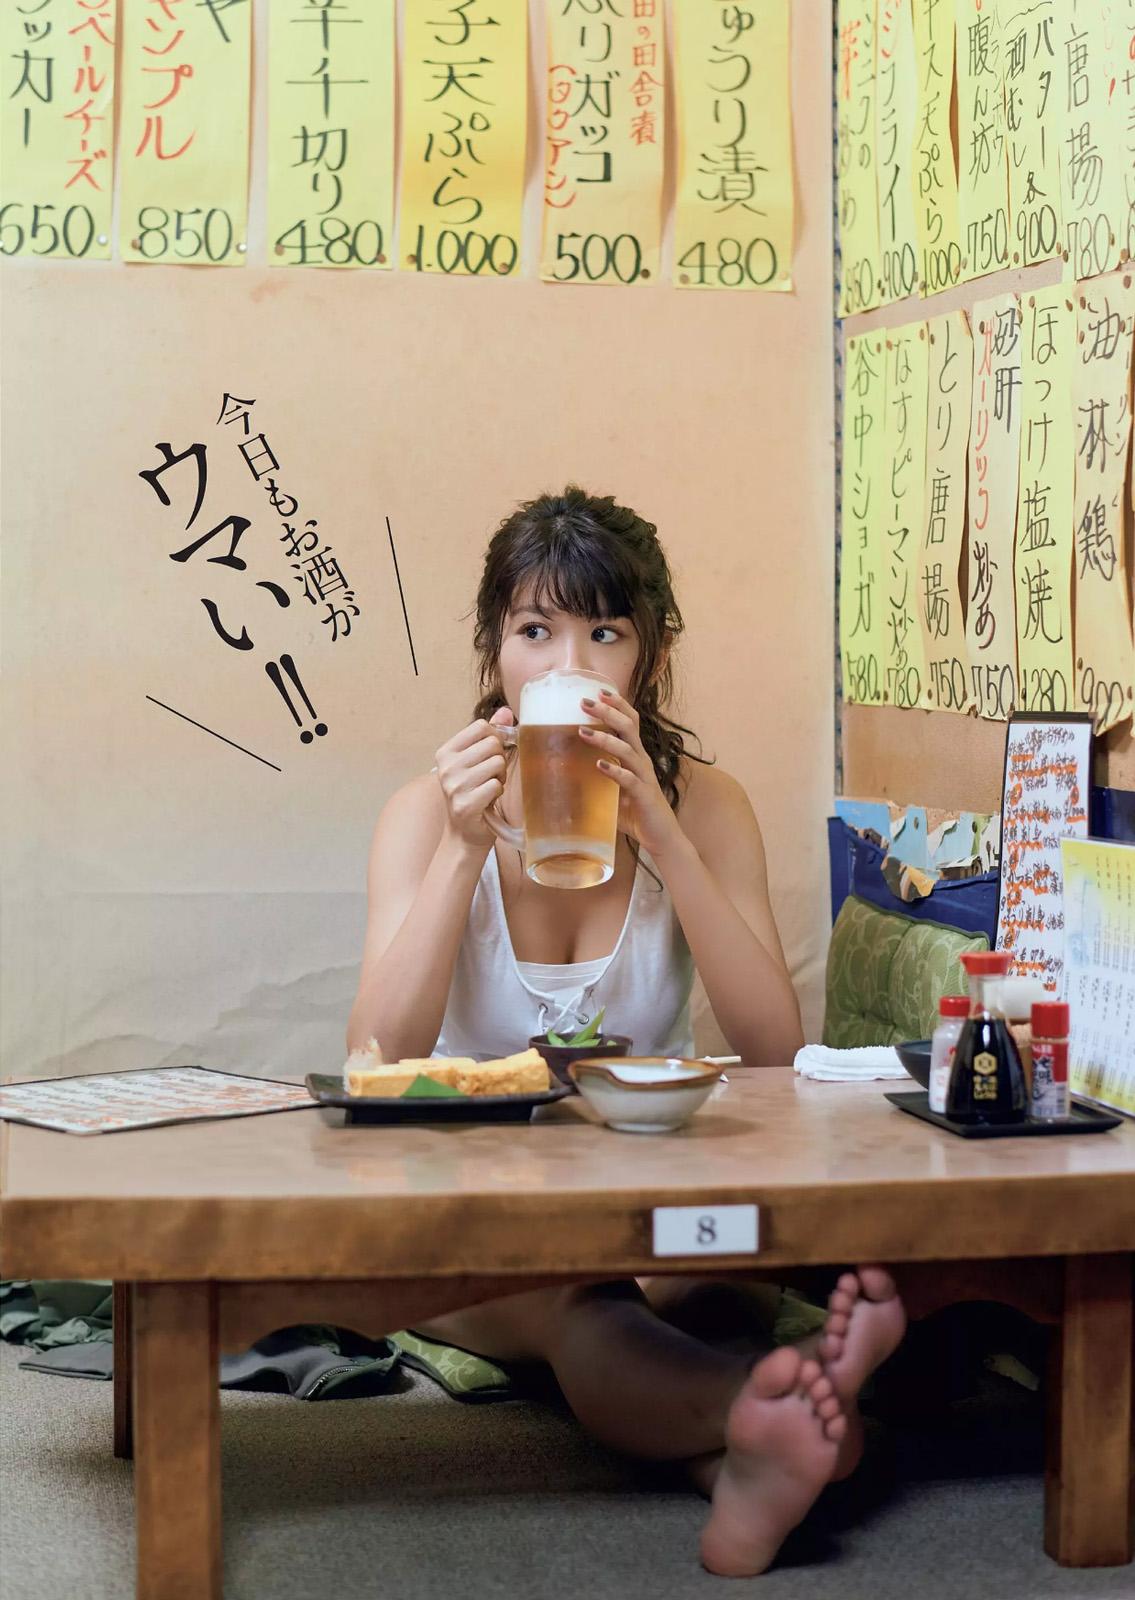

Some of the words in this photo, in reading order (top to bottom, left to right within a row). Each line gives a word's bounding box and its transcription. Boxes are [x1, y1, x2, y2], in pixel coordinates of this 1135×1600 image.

[1064, 0, 1103, 211] 唐揚
[0, 203, 95, 257] 650
[137, 207, 233, 262] 850
[276, 217, 384, 265] 480
[967, 207, 1008, 272] 750
[1016, 203, 1057, 268] 900
[1066, 213, 1112, 281] 780
[552, 233, 642, 284] 500
[678, 237, 778, 287] 480
[846, 651, 878, 702] 580
[930, 657, 967, 711] 750
[971, 664, 1015, 718] 750
[697, 1215, 717, 1246] 8
